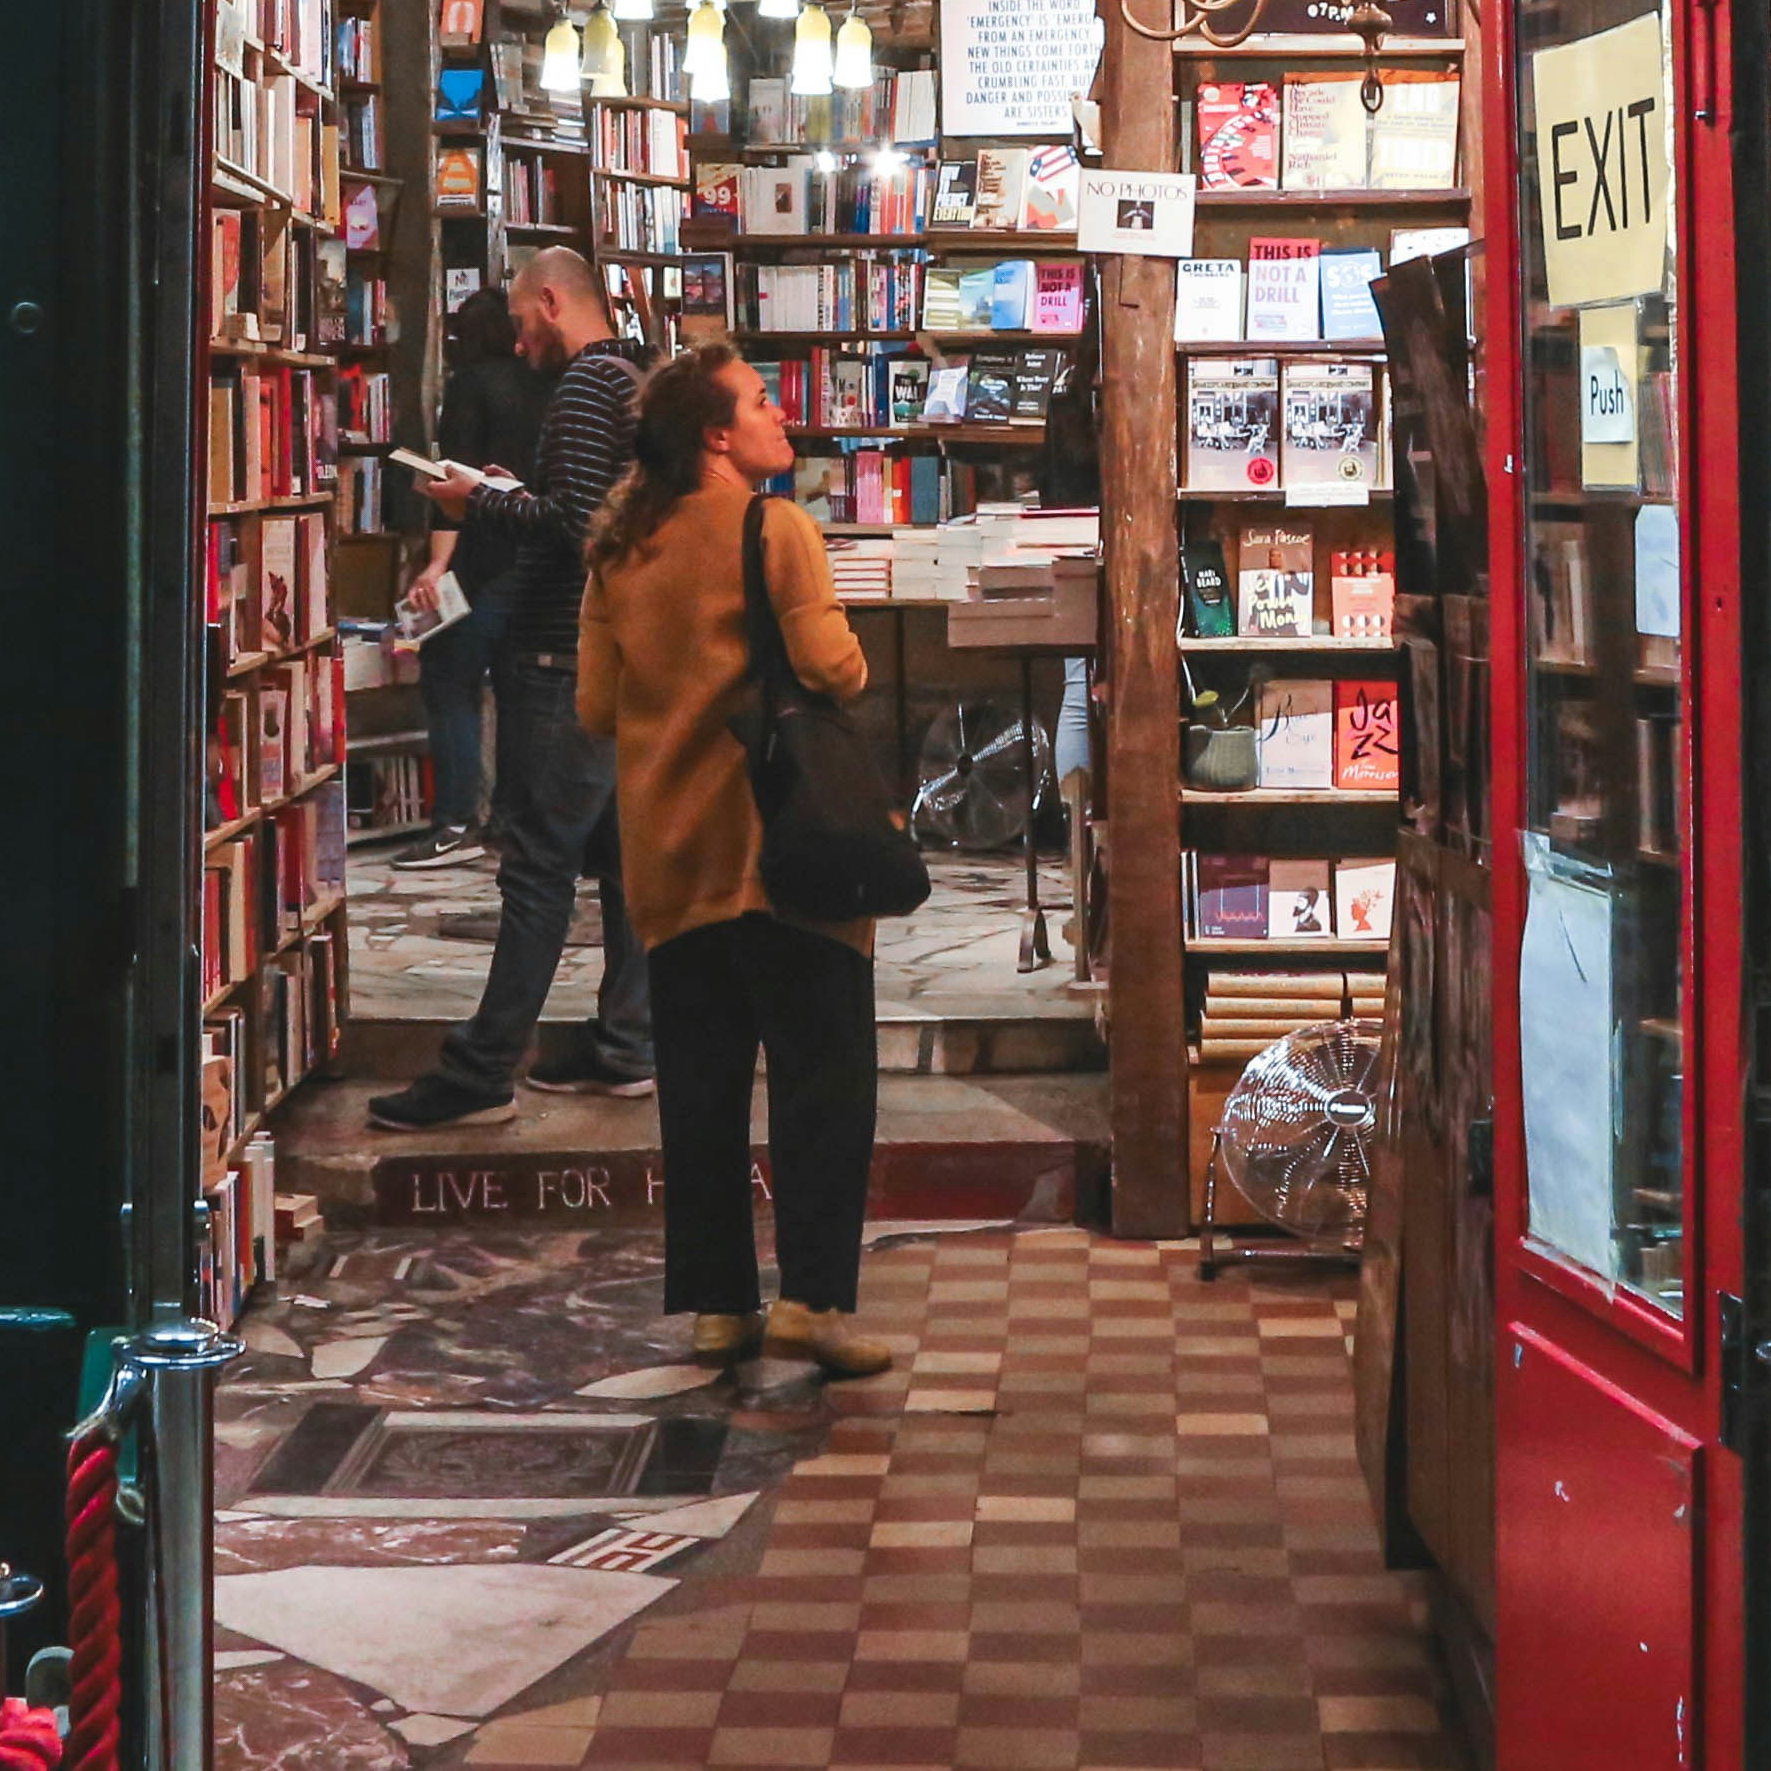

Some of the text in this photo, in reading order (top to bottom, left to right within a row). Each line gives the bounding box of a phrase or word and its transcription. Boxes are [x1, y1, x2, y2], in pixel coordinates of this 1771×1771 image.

[988, 0, 1023, 12] INSIDE
[1039, 13, 1050, 26] IS
[978, 29, 1090, 43] FROM AN EMERGENCY
[967, 46, 990, 58] NEW
[994, 45, 1031, 58] THINGS
[1034, 45, 1065, 57] COME
[969, 59, 1080, 73] THE OLD CERTAINTIES
[978, 76, 1038, 89] CRUMBLING
[966, 91, 1034, 104] DANGER AND
[1004, 104, 1068, 118] ARE SISTERS
[1288, 160, 1311, 171] Rich
[1551, 98, 1656, 240] EXIT
[1086, 181, 1188, 199] NO PHOTOS
[1253, 245, 1312, 260] THIS IS
[1040, 268, 1075, 280] THIS IS
[1182, 262, 1235, 273] GRETA
[1255, 265, 1307, 282] NOT A
[1040, 281, 1072, 293] NOT A
[1040, 295, 1067, 307] DRILL
[1254, 286, 1300, 303] DRILL
[1590, 370, 1625, 416] Push
[413, 1170, 509, 1213] LIVE
[538, 1168, 610, 1209] FOR
